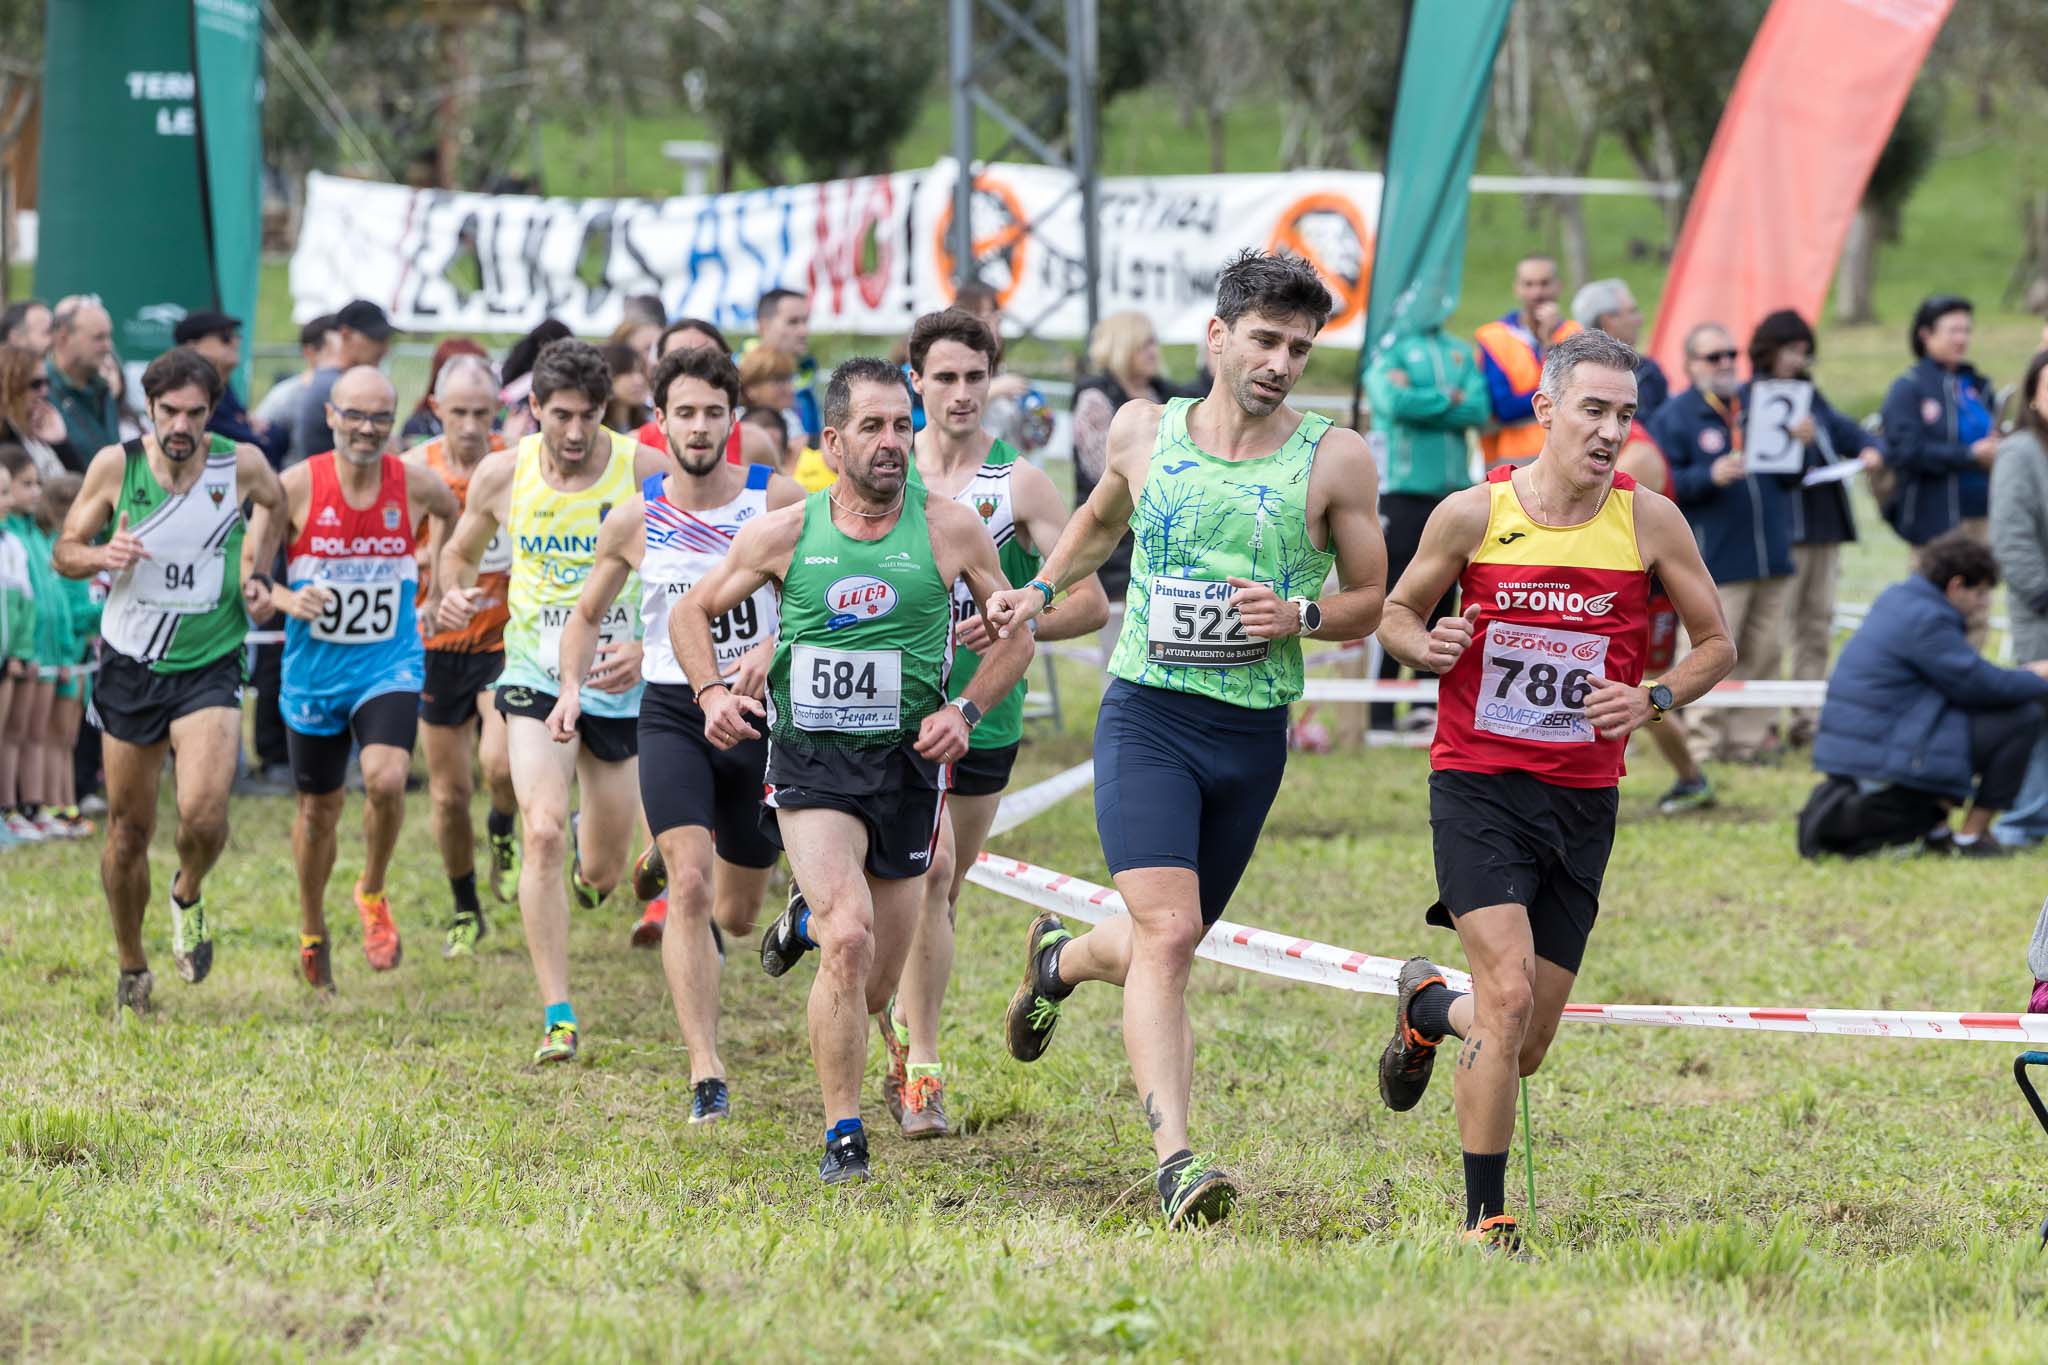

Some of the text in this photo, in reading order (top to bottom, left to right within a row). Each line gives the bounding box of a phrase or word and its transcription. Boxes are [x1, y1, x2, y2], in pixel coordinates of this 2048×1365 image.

[1757, 395, 1793, 462] 3
[310, 536, 406, 555] POLANCO
[165, 563, 195, 590] 94
[838, 584, 887, 609] LUCA
[1155, 583, 1201, 599] Pinturas
[1495, 591, 1584, 613] OZONO
[319, 587, 393, 634] 925
[1172, 602, 1248, 643] 522
[1164, 648, 1225, 658] AYUNTAMIENTO
[1226, 649, 1235, 658] de
[1493, 633, 1568, 654] OZONO
[812, 658, 877, 700] 584
[1491, 656, 1593, 709] 786
